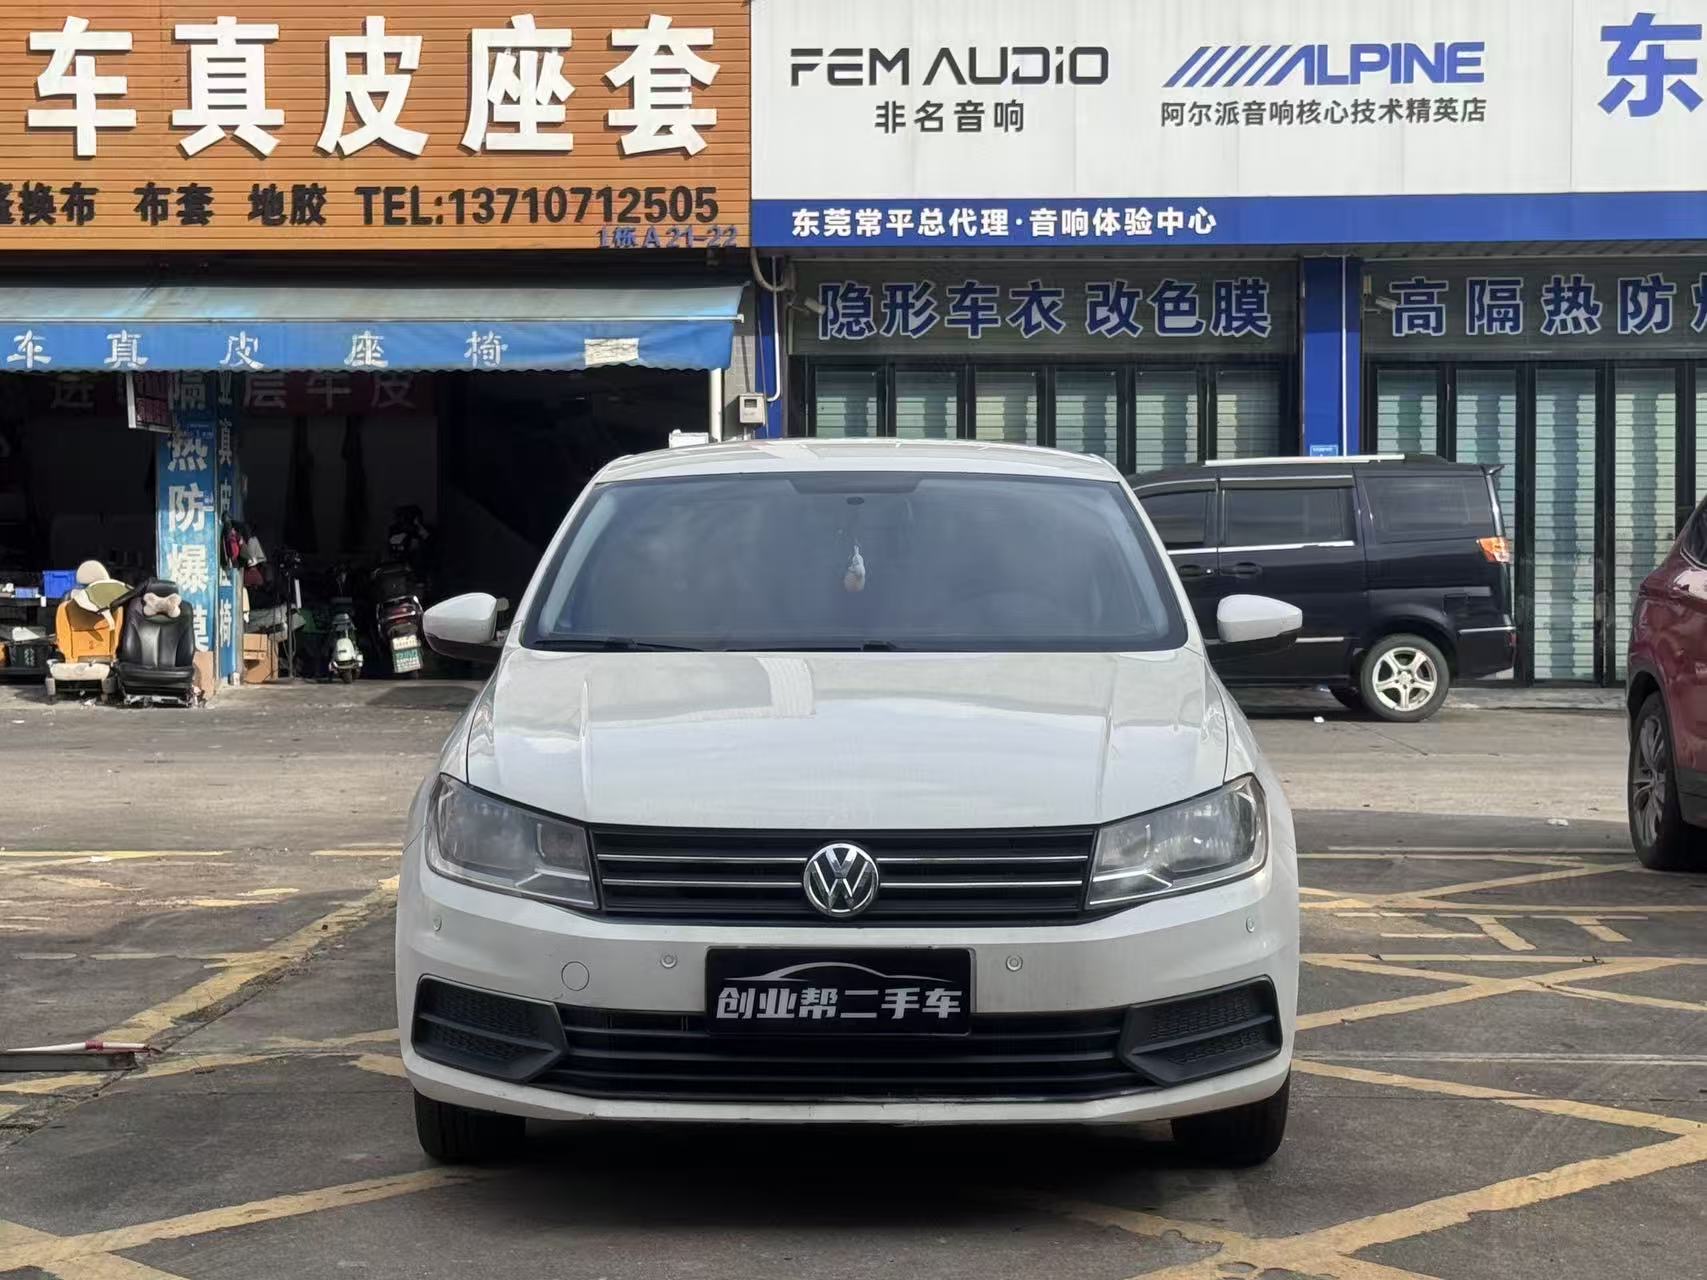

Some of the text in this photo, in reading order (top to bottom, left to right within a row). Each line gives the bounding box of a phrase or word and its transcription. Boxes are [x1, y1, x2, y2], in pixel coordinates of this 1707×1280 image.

[791, 47, 910, 86] FEM
[1263, 42, 1486, 86] ALPINE
[1598, 12, 1704, 118] 东
[27, 15, 721, 159] 车真皮座套
[875, 100, 1025, 134] 非名音响
[1160, 97, 1487, 128] 阿尔派音响核心技术精英店
[134, 182, 214, 227] 布套
[248, 183, 327, 227] 地胶
[818, 277, 1273, 340] 隐形车衣 改色膜
[1389, 273, 1707, 337] 高隔热防
[7, 329, 509, 369] 车真皮座椅
[716, 987, 962, 1020] 创业帮二手车
